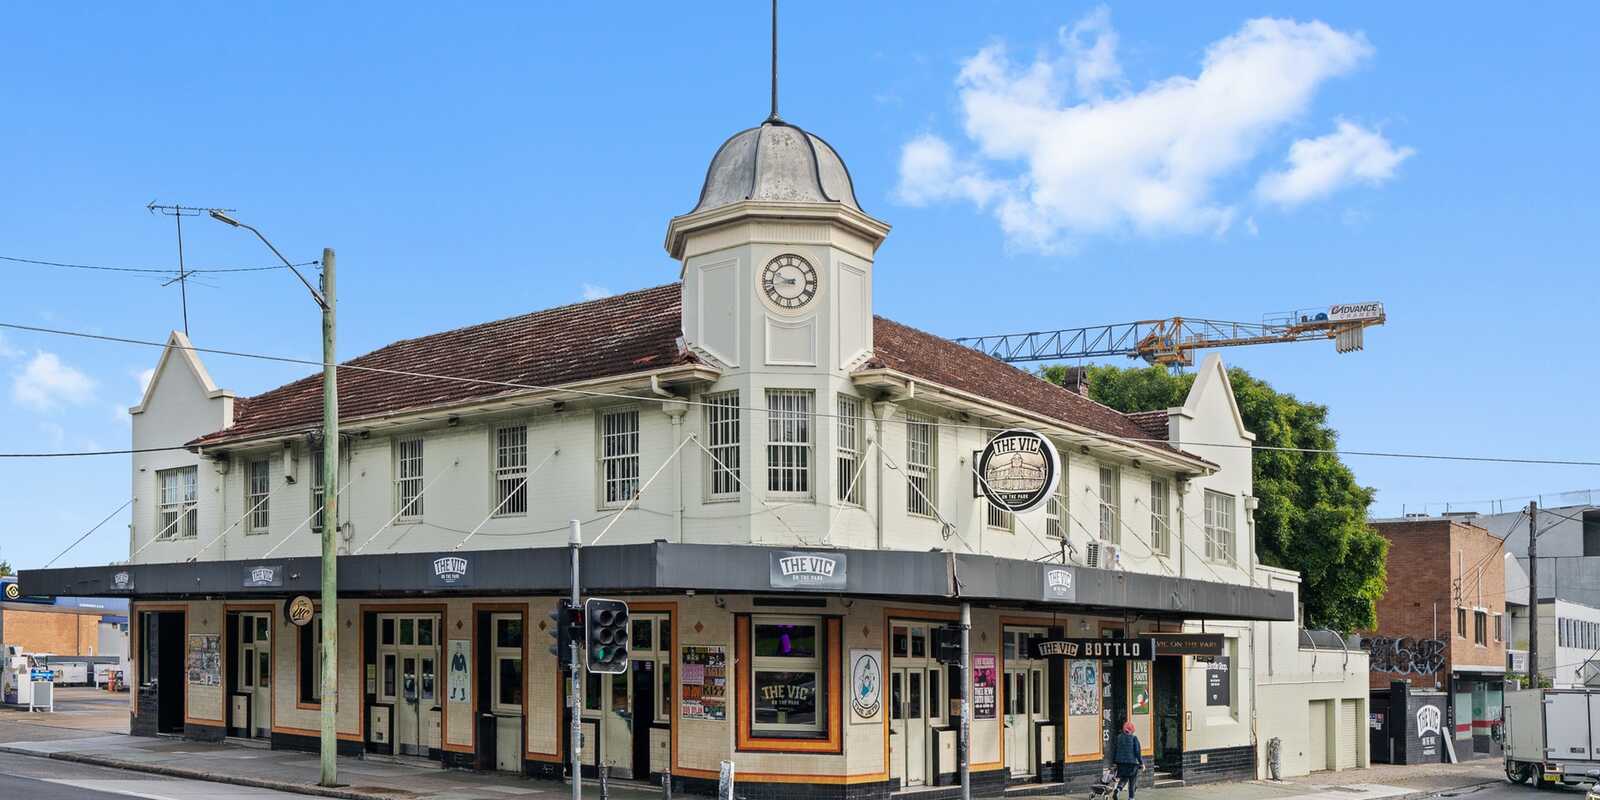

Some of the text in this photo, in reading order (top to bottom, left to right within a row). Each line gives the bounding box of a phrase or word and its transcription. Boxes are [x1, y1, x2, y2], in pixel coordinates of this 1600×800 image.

[994, 438, 1039, 453] THE VIC
[435, 558, 464, 574] THE VIC
[782, 557, 832, 574] THE VIC
[1049, 572, 1070, 585] THE VIC
[1039, 642, 1140, 656] THE VIC BOTTLO
[762, 685, 808, 700] THE VIC
[1418, 708, 1428, 732] THE
[1428, 708, 1438, 730] VIC
